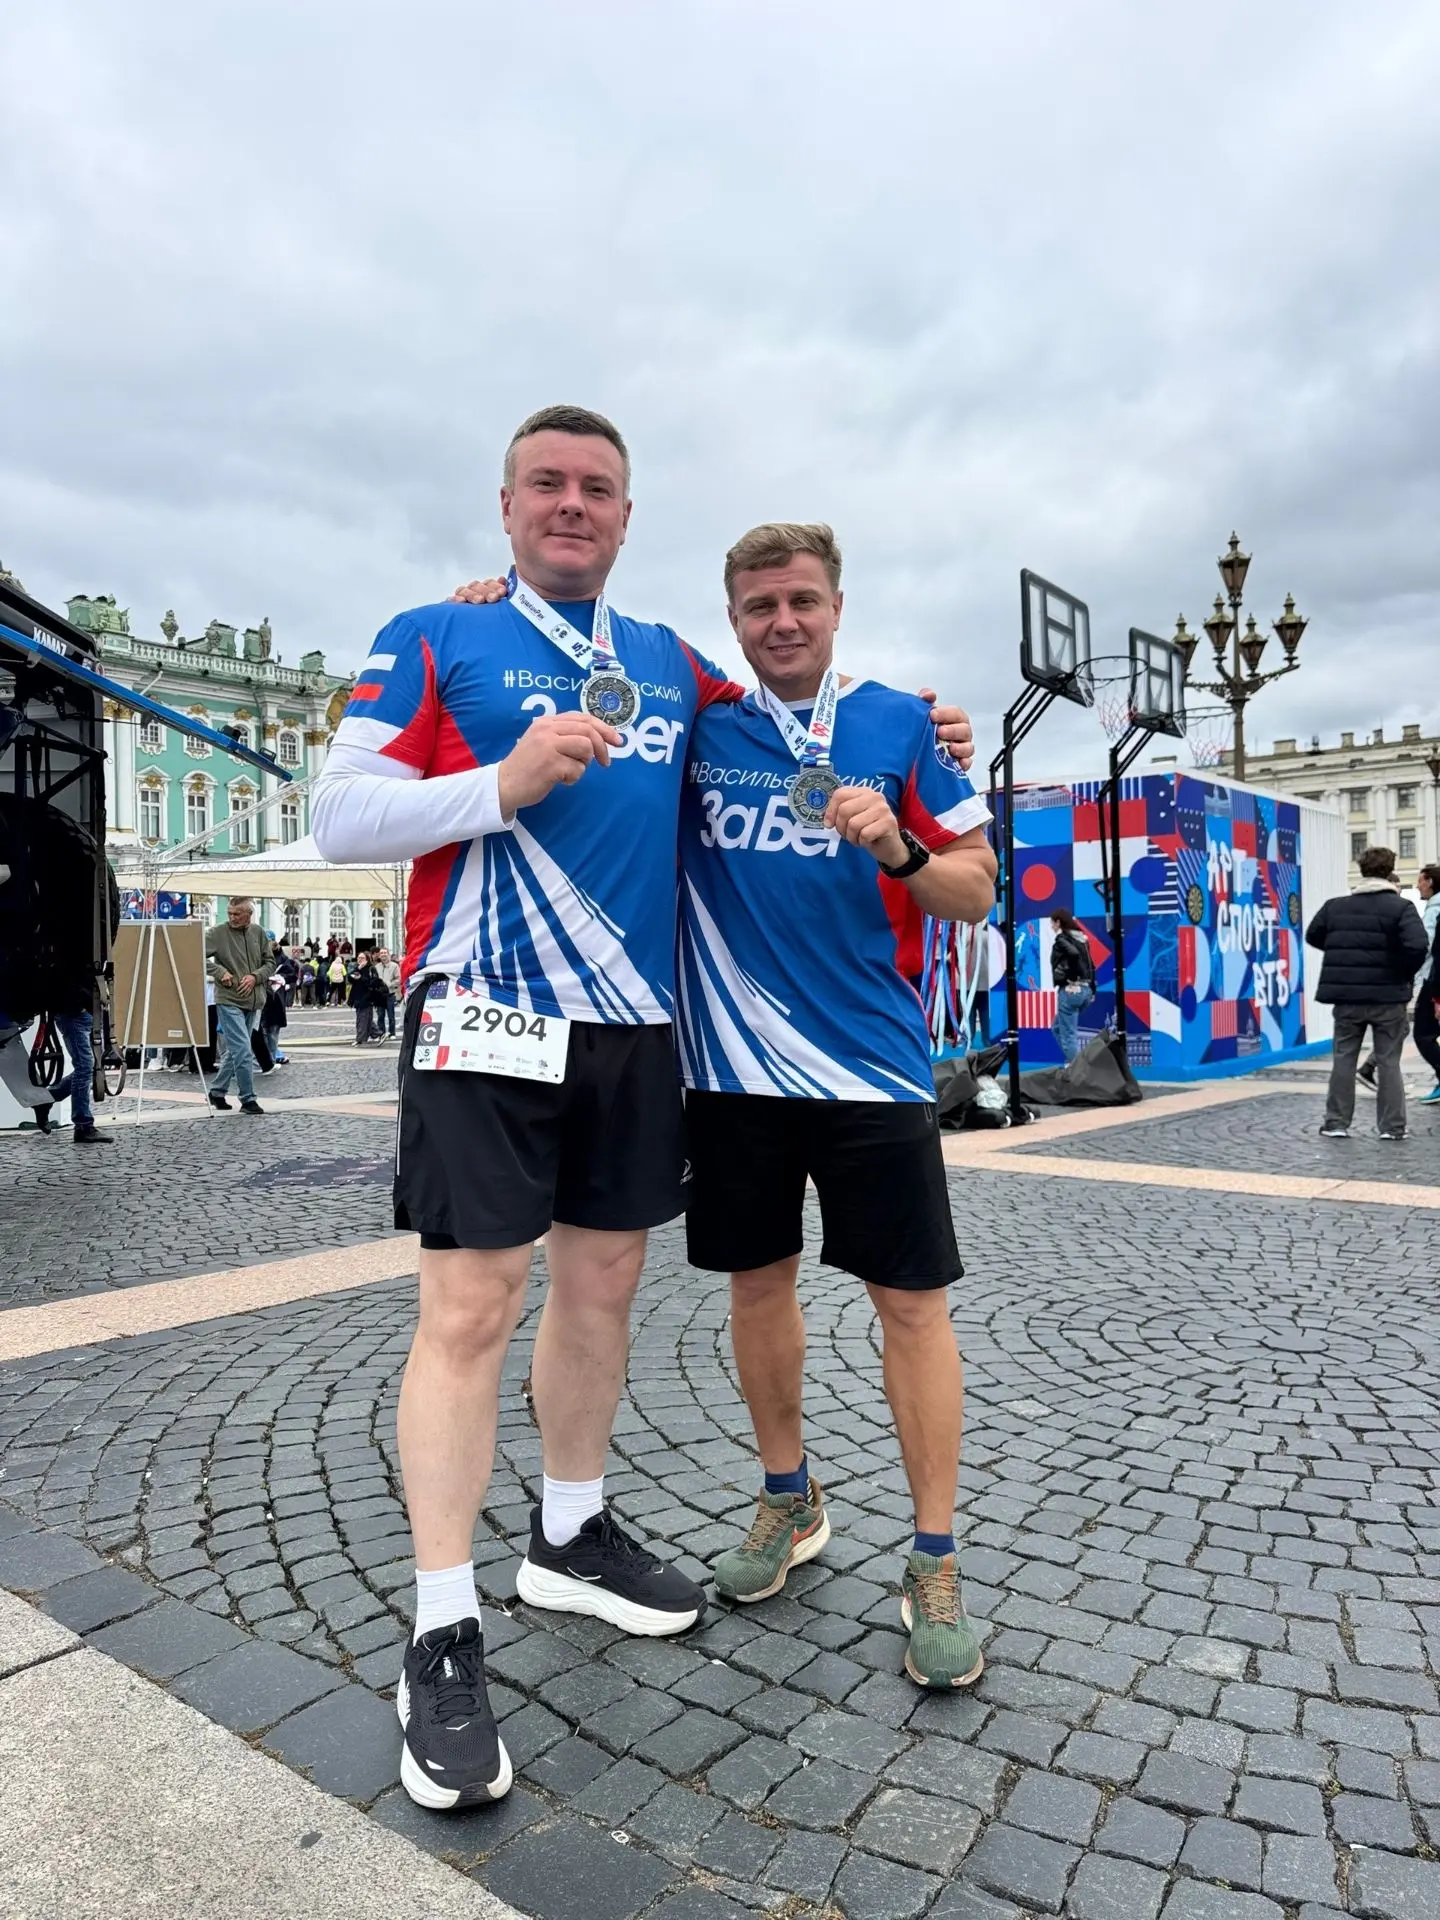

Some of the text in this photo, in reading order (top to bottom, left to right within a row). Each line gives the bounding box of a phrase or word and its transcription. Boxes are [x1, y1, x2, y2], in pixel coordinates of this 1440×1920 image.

[502, 669, 683, 705] #Васиский
[689, 761, 886, 794] #Васильекий
[1206, 840, 1248, 898] АРТ
[1217, 900, 1277, 955] СПОРТ
[1252, 959, 1289, 1009] ВТБ
[460, 1005, 547, 1042] 2904
[443, 1656, 454, 1679] HOKA
